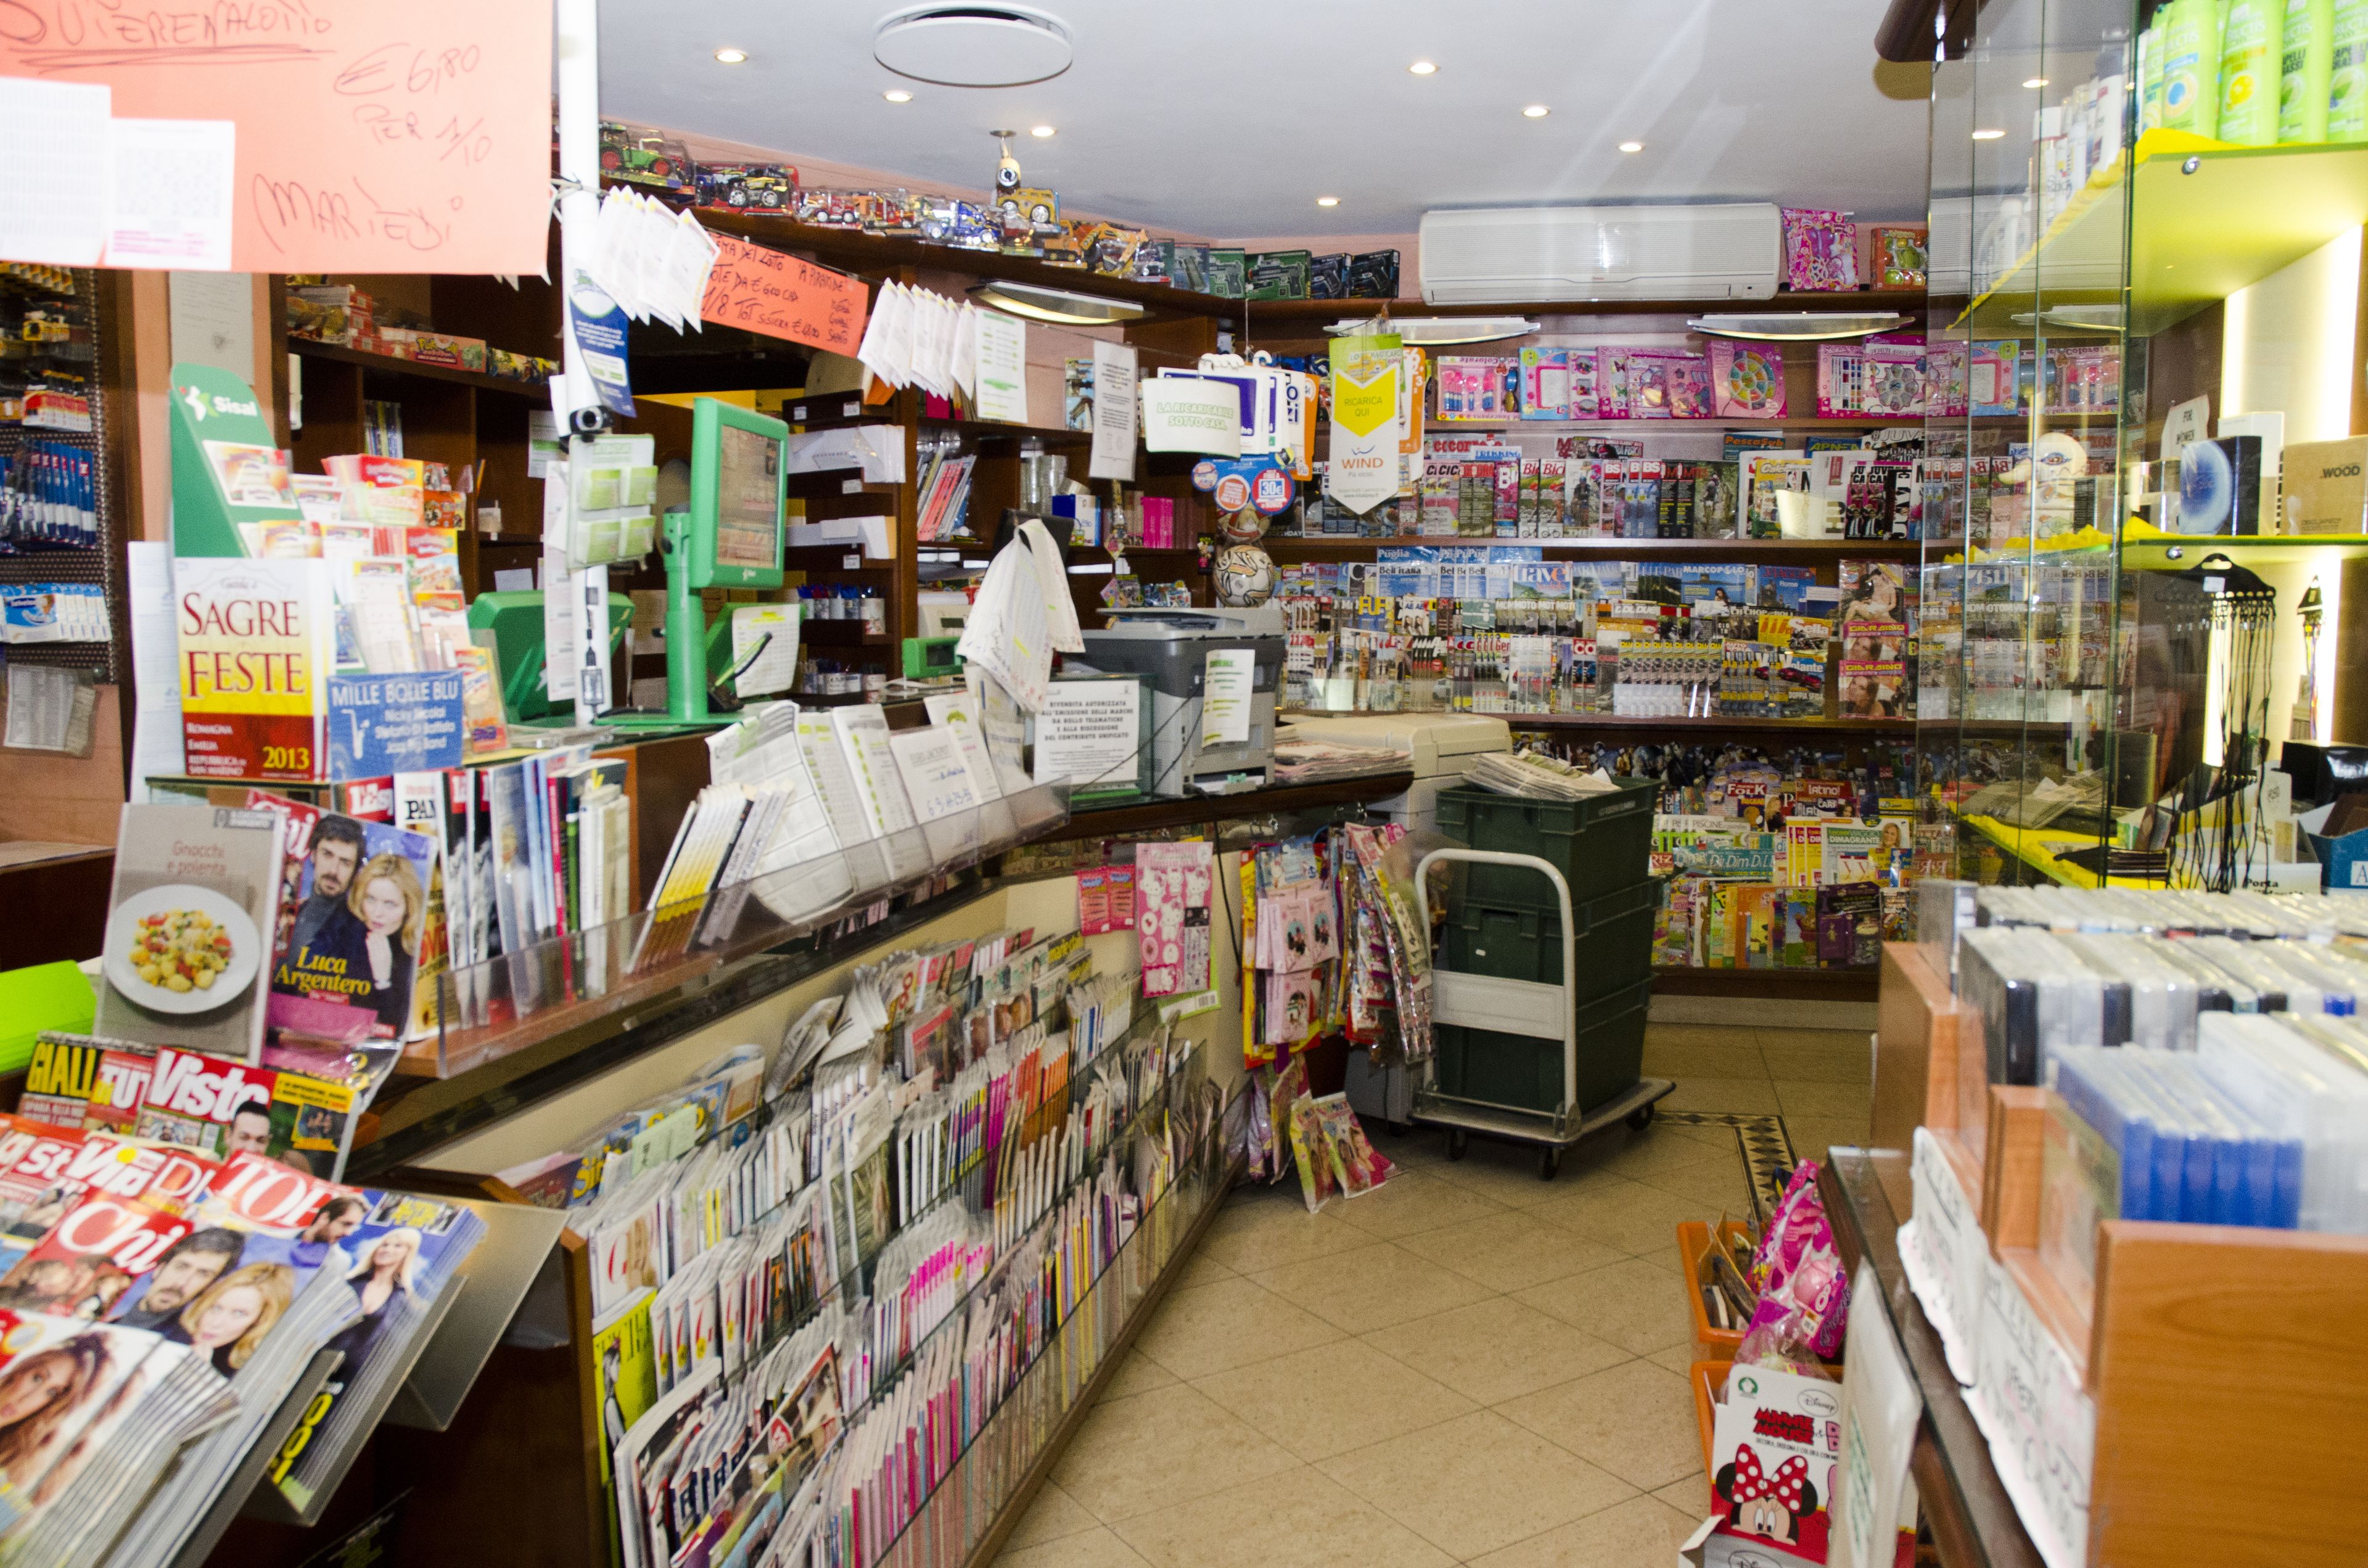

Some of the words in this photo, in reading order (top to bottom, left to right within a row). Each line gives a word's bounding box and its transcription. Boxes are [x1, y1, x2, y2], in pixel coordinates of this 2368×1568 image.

[408, 44, 480, 94] 6,80
[213, 395, 258, 418] Sisal
[1344, 396, 1383, 406] RICARICA
[1156, 403, 1171, 413] LA
[1173, 403, 1234, 419] RICARICABILE
[1355, 408, 1370, 417] QUI
[1168, 416, 1202, 428] SOTTO
[1341, 458, 1384, 469] WIND
[1378, 548, 1410, 559] Puglia
[183, 591, 300, 637] SAGRE
[185, 651, 305, 698] FESTE
[332, 683, 380, 707] MILLE
[384, 682, 430, 704] BOLLE
[433, 680, 459, 700] BLU
[186, 723, 234, 734] ROMAGNA
[261, 746, 310, 771] 2013
[1692, 821, 1723, 829] PISCINE
[172, 839, 226, 858] Gnocchi
[1829, 836, 1881, 844] DIMAGRANTE
[176, 861, 228, 878] polenta
[297, 946, 348, 974] Luca
[274, 963, 371, 996] Argentero
[57, 1201, 187, 1274] Chi
[1805, 1397, 1836, 1413] Disney
